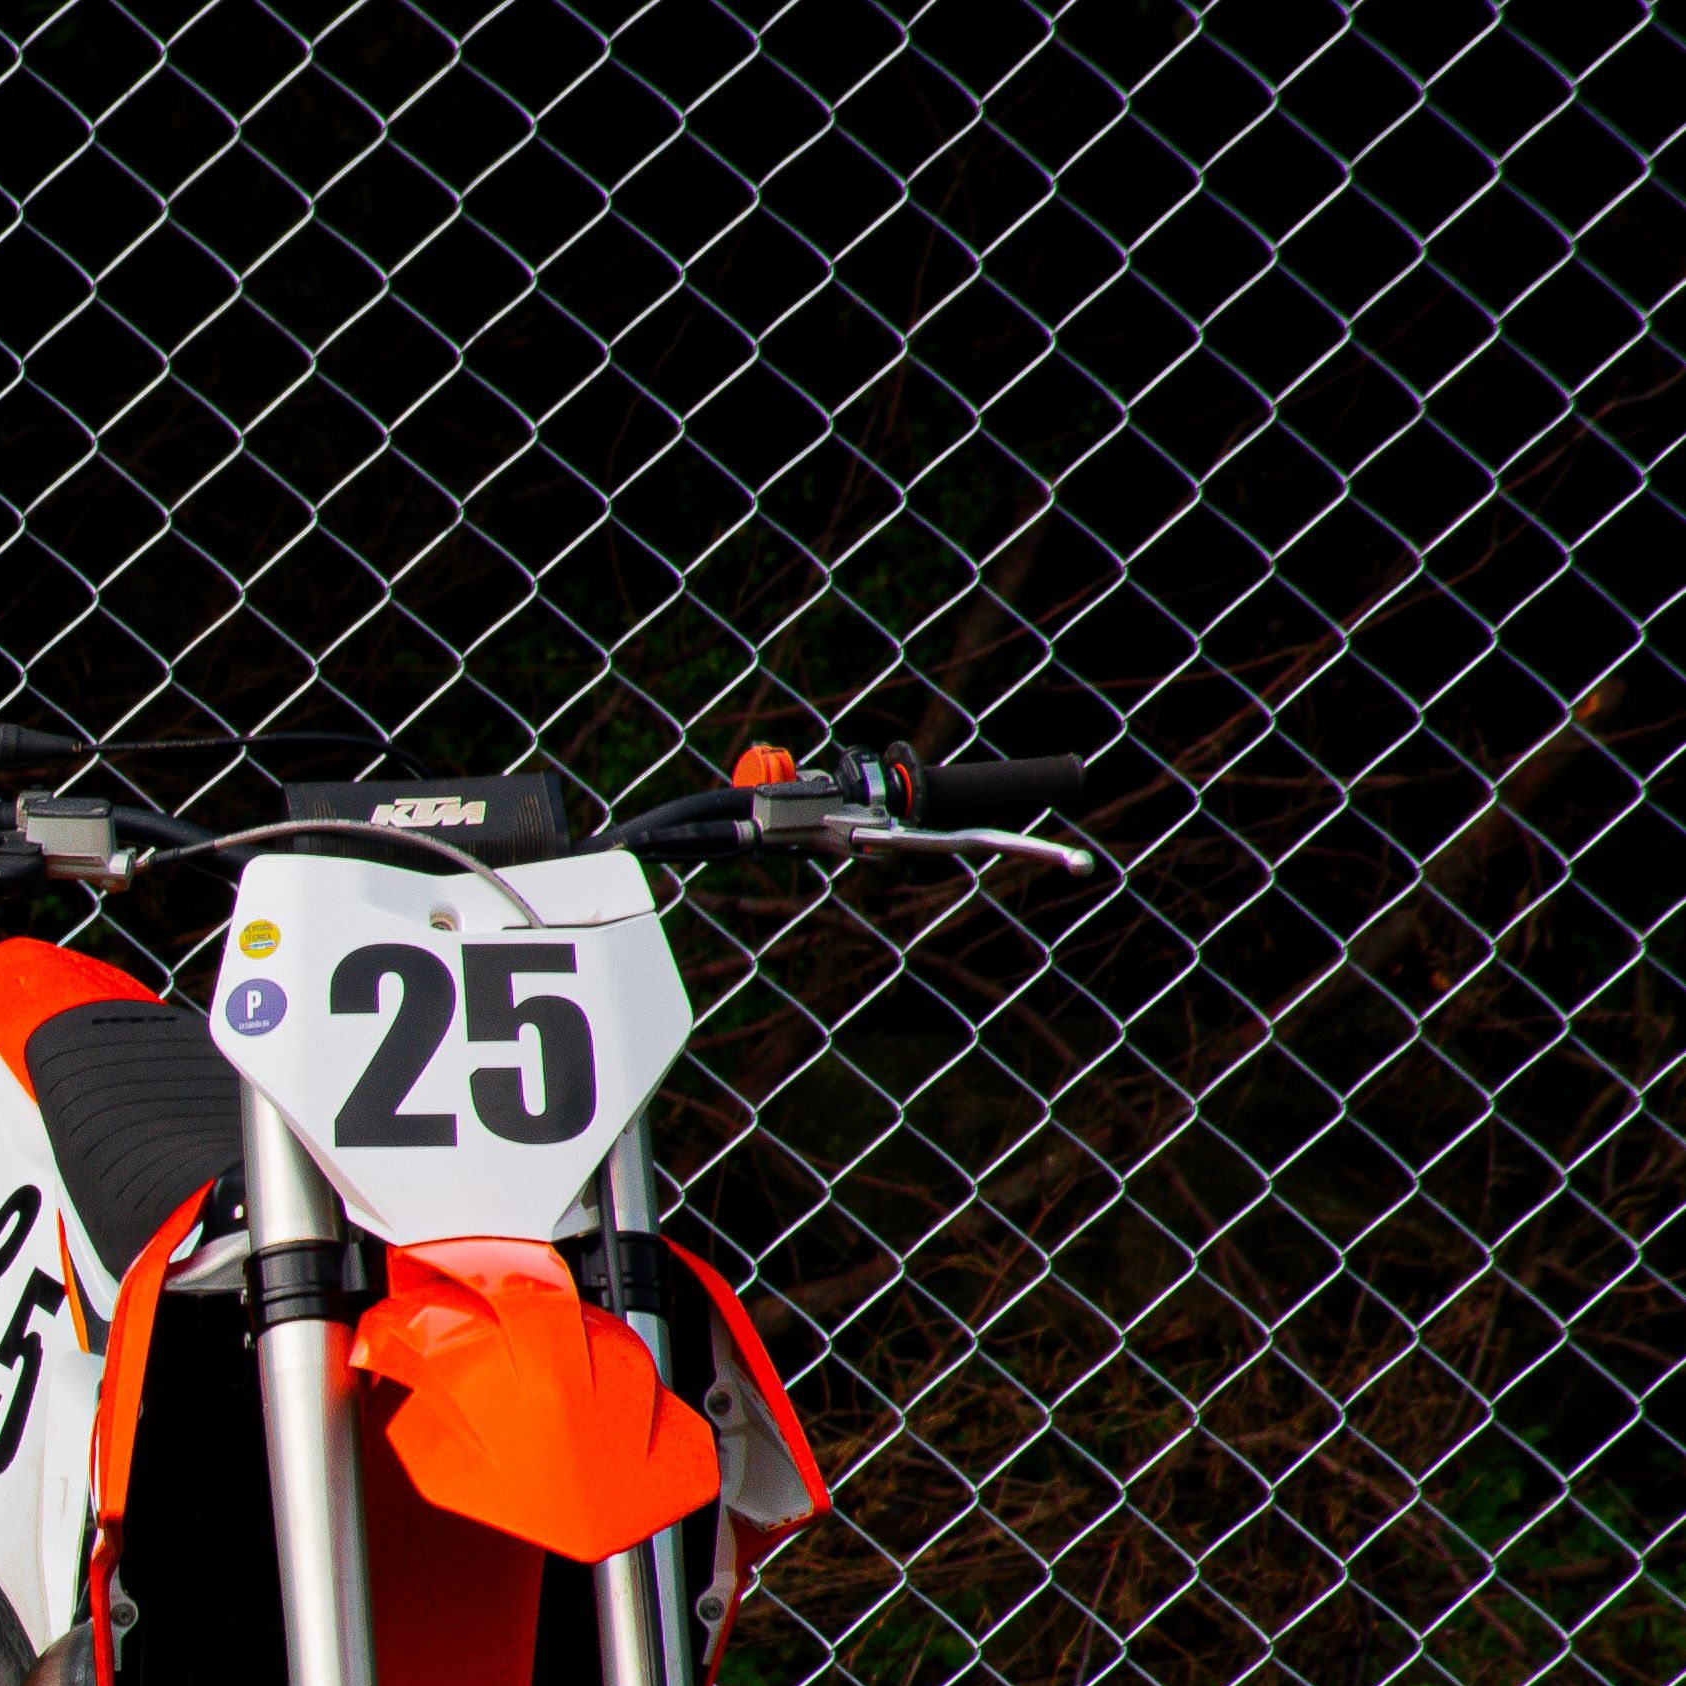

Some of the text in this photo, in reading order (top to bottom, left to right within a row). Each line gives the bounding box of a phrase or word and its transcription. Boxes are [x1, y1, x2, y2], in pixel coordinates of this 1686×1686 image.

[371, 796, 487, 828] KTM
[246, 989, 263, 1020] P
[329, 943, 596, 1147] 25
